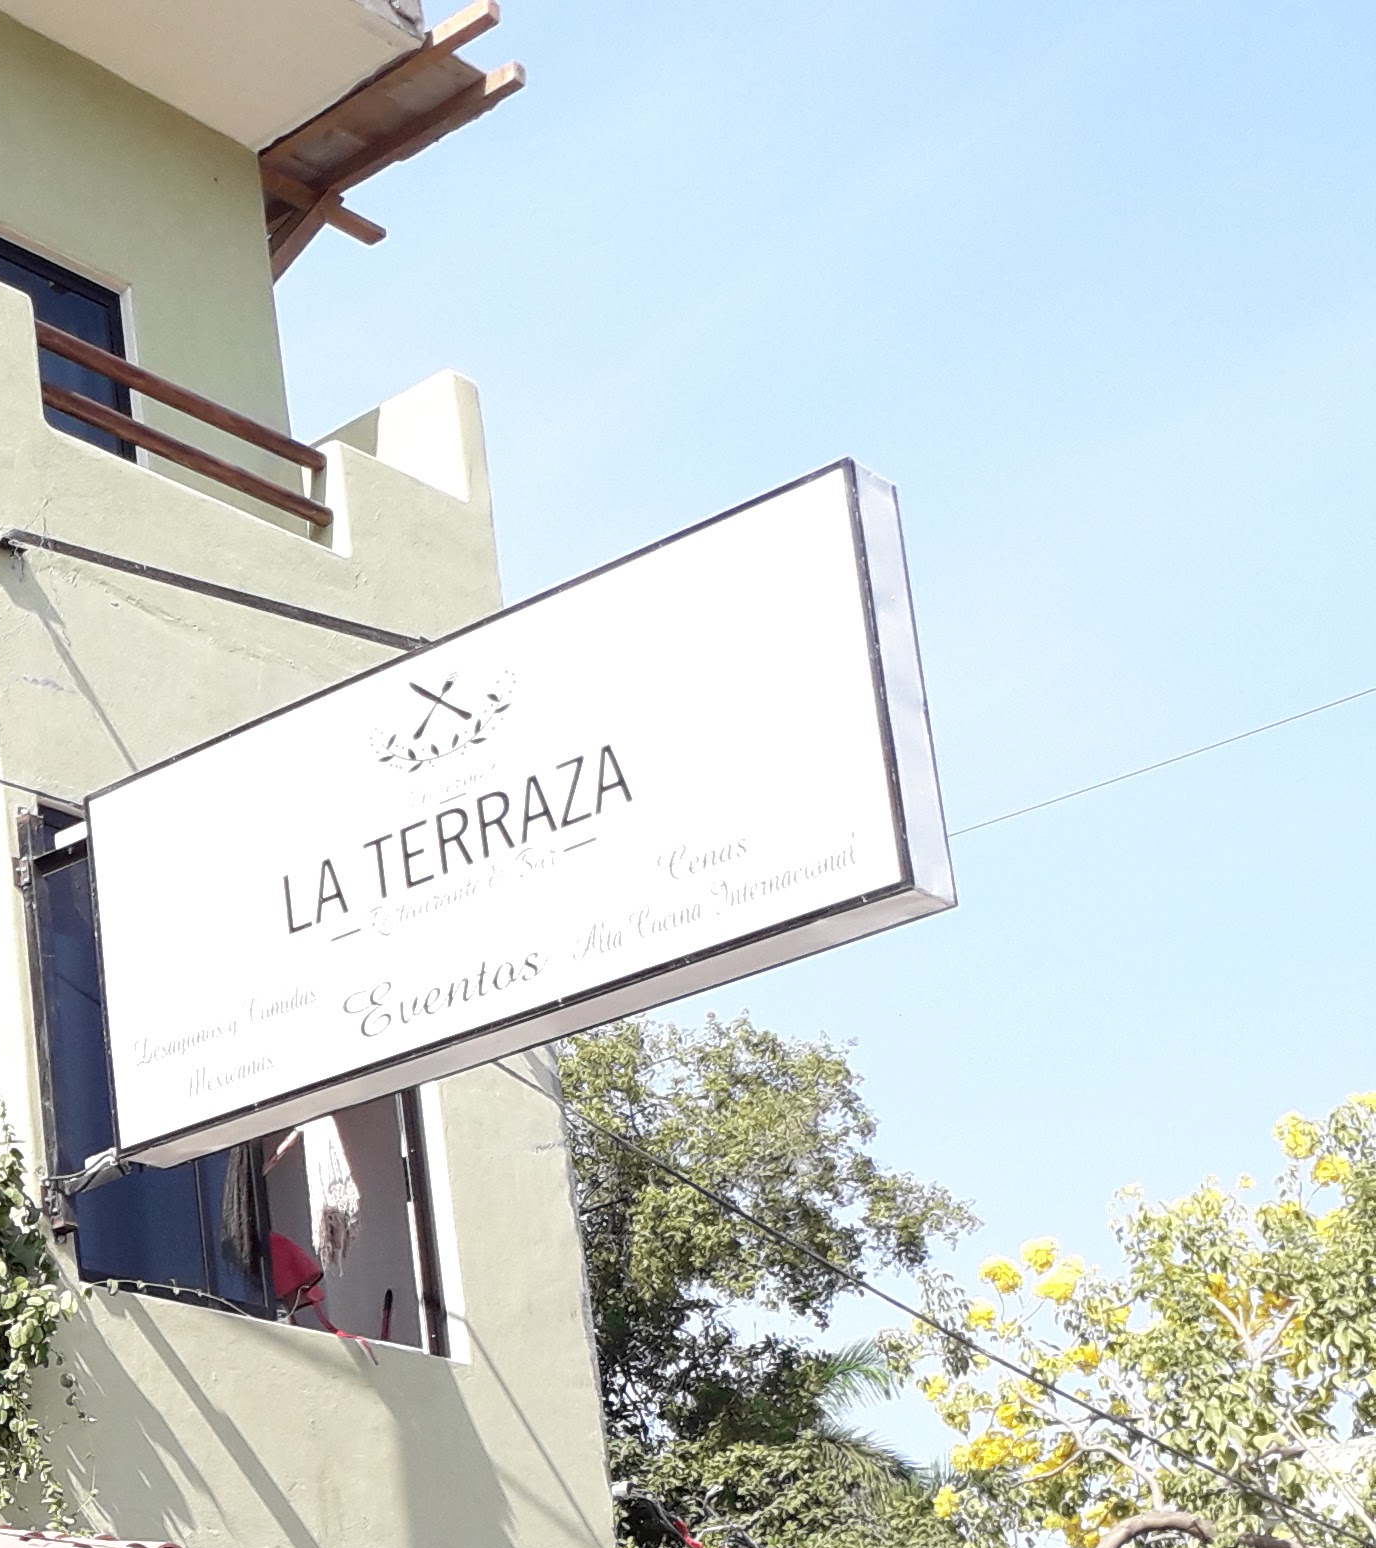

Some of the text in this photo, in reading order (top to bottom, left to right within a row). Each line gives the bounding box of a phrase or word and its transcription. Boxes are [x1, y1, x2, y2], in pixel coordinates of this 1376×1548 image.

[282, 743, 634, 935] LA TERRAZA
[656, 836, 749, 880] Cenas
[343, 945, 550, 1039] Eventos
